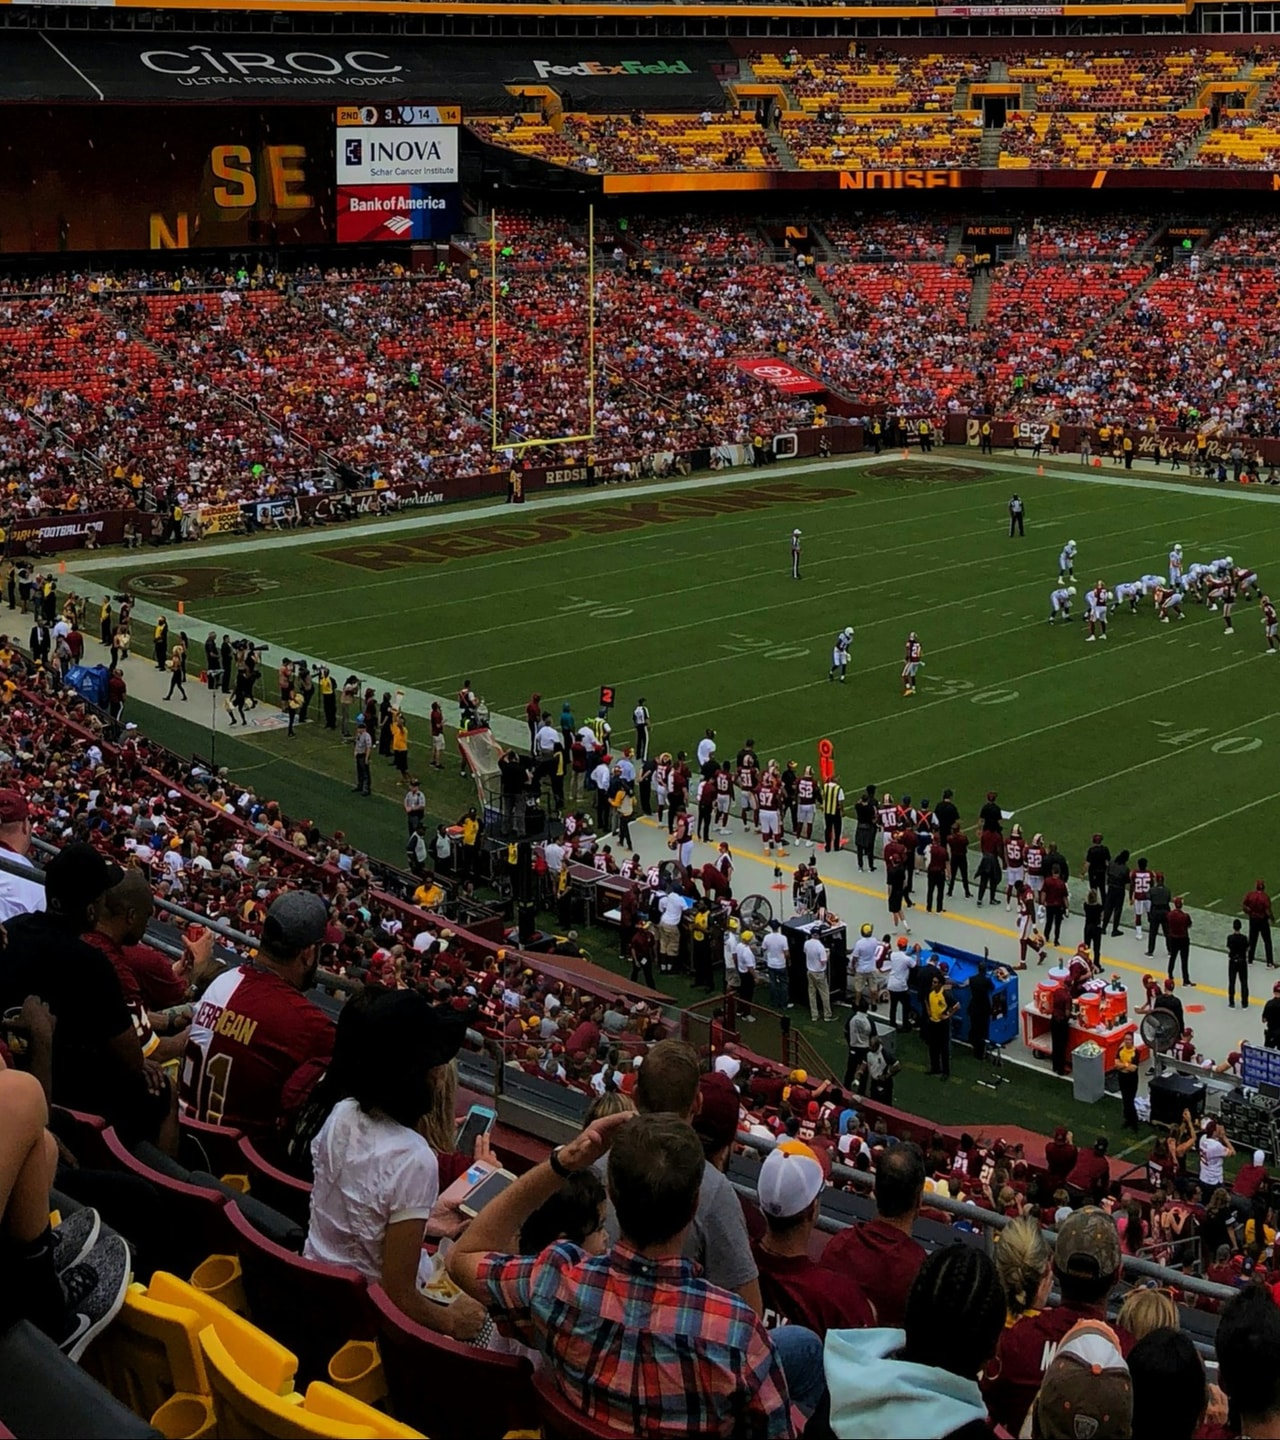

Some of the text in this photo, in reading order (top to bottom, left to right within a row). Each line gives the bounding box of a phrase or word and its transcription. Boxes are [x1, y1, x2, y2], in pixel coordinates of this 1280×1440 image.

[533, 60, 692, 79] FedExField
[177, 76, 405, 86] ULTRA PREMIUM VODKA
[340, 109, 431, 122] 2ND 3 14
[370, 141, 441, 162] INOVA
[370, 166, 455, 177] Schar Cancer Institute
[350, 195, 447, 212] Bank of America
[310, 483, 860, 572] REDSKINS
[603, 689, 613, 703] 2
[740, 773, 752, 788] 31
[799, 784, 813, 799] 52
[759, 792, 773, 807] 97
[881, 812, 897, 827] 40
[1007, 846, 1021, 861] 56
[1027, 854, 1041, 868] 22
[1135, 878, 1150, 893] 25
